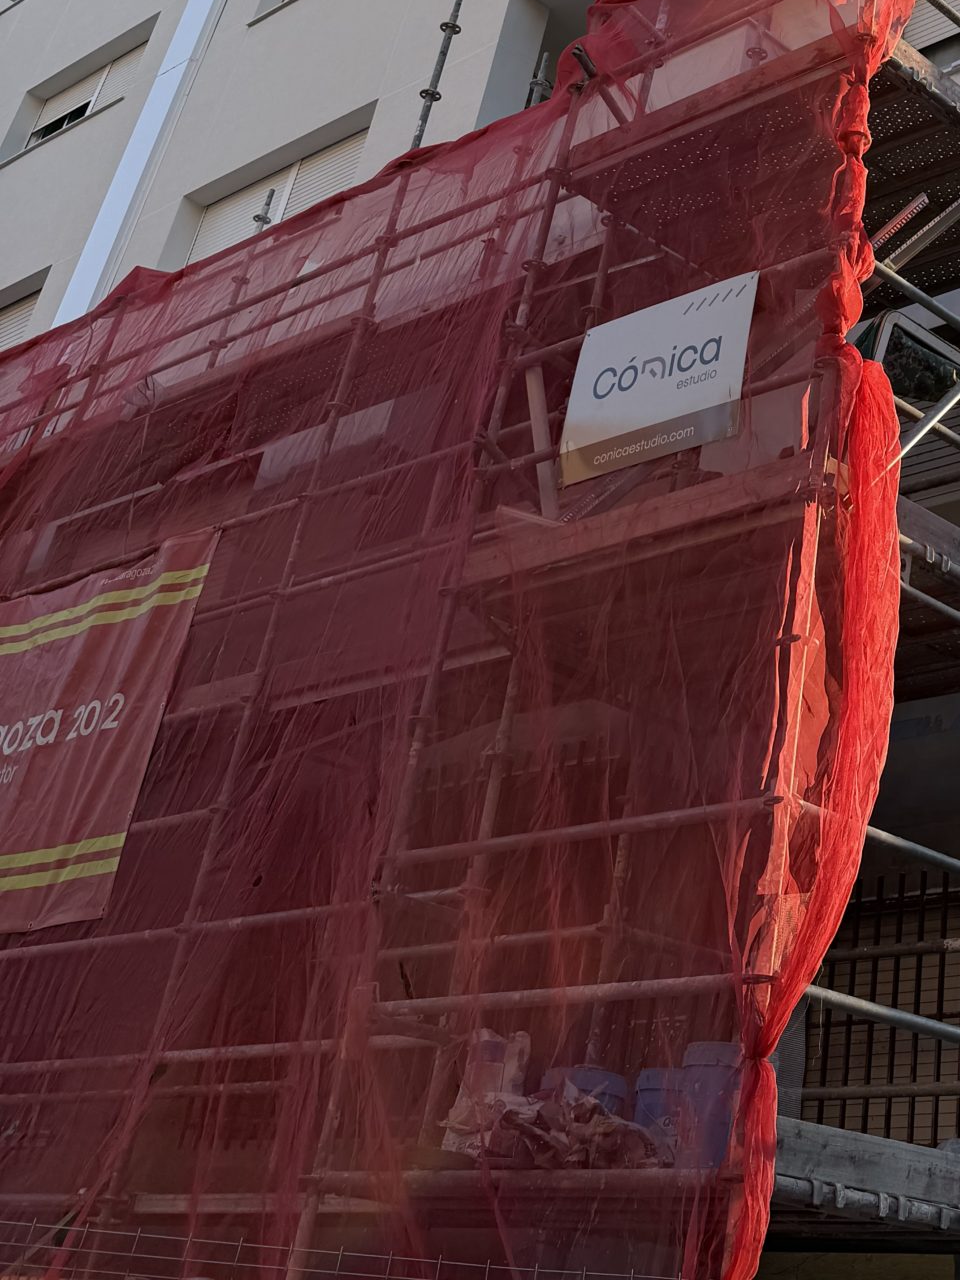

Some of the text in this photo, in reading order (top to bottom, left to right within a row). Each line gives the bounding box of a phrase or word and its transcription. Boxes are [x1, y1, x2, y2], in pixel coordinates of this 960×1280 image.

[592, 335, 723, 400] Cónica
[676, 369, 718, 390] estudio
[593, 425, 695, 465] conicaestudio.com
